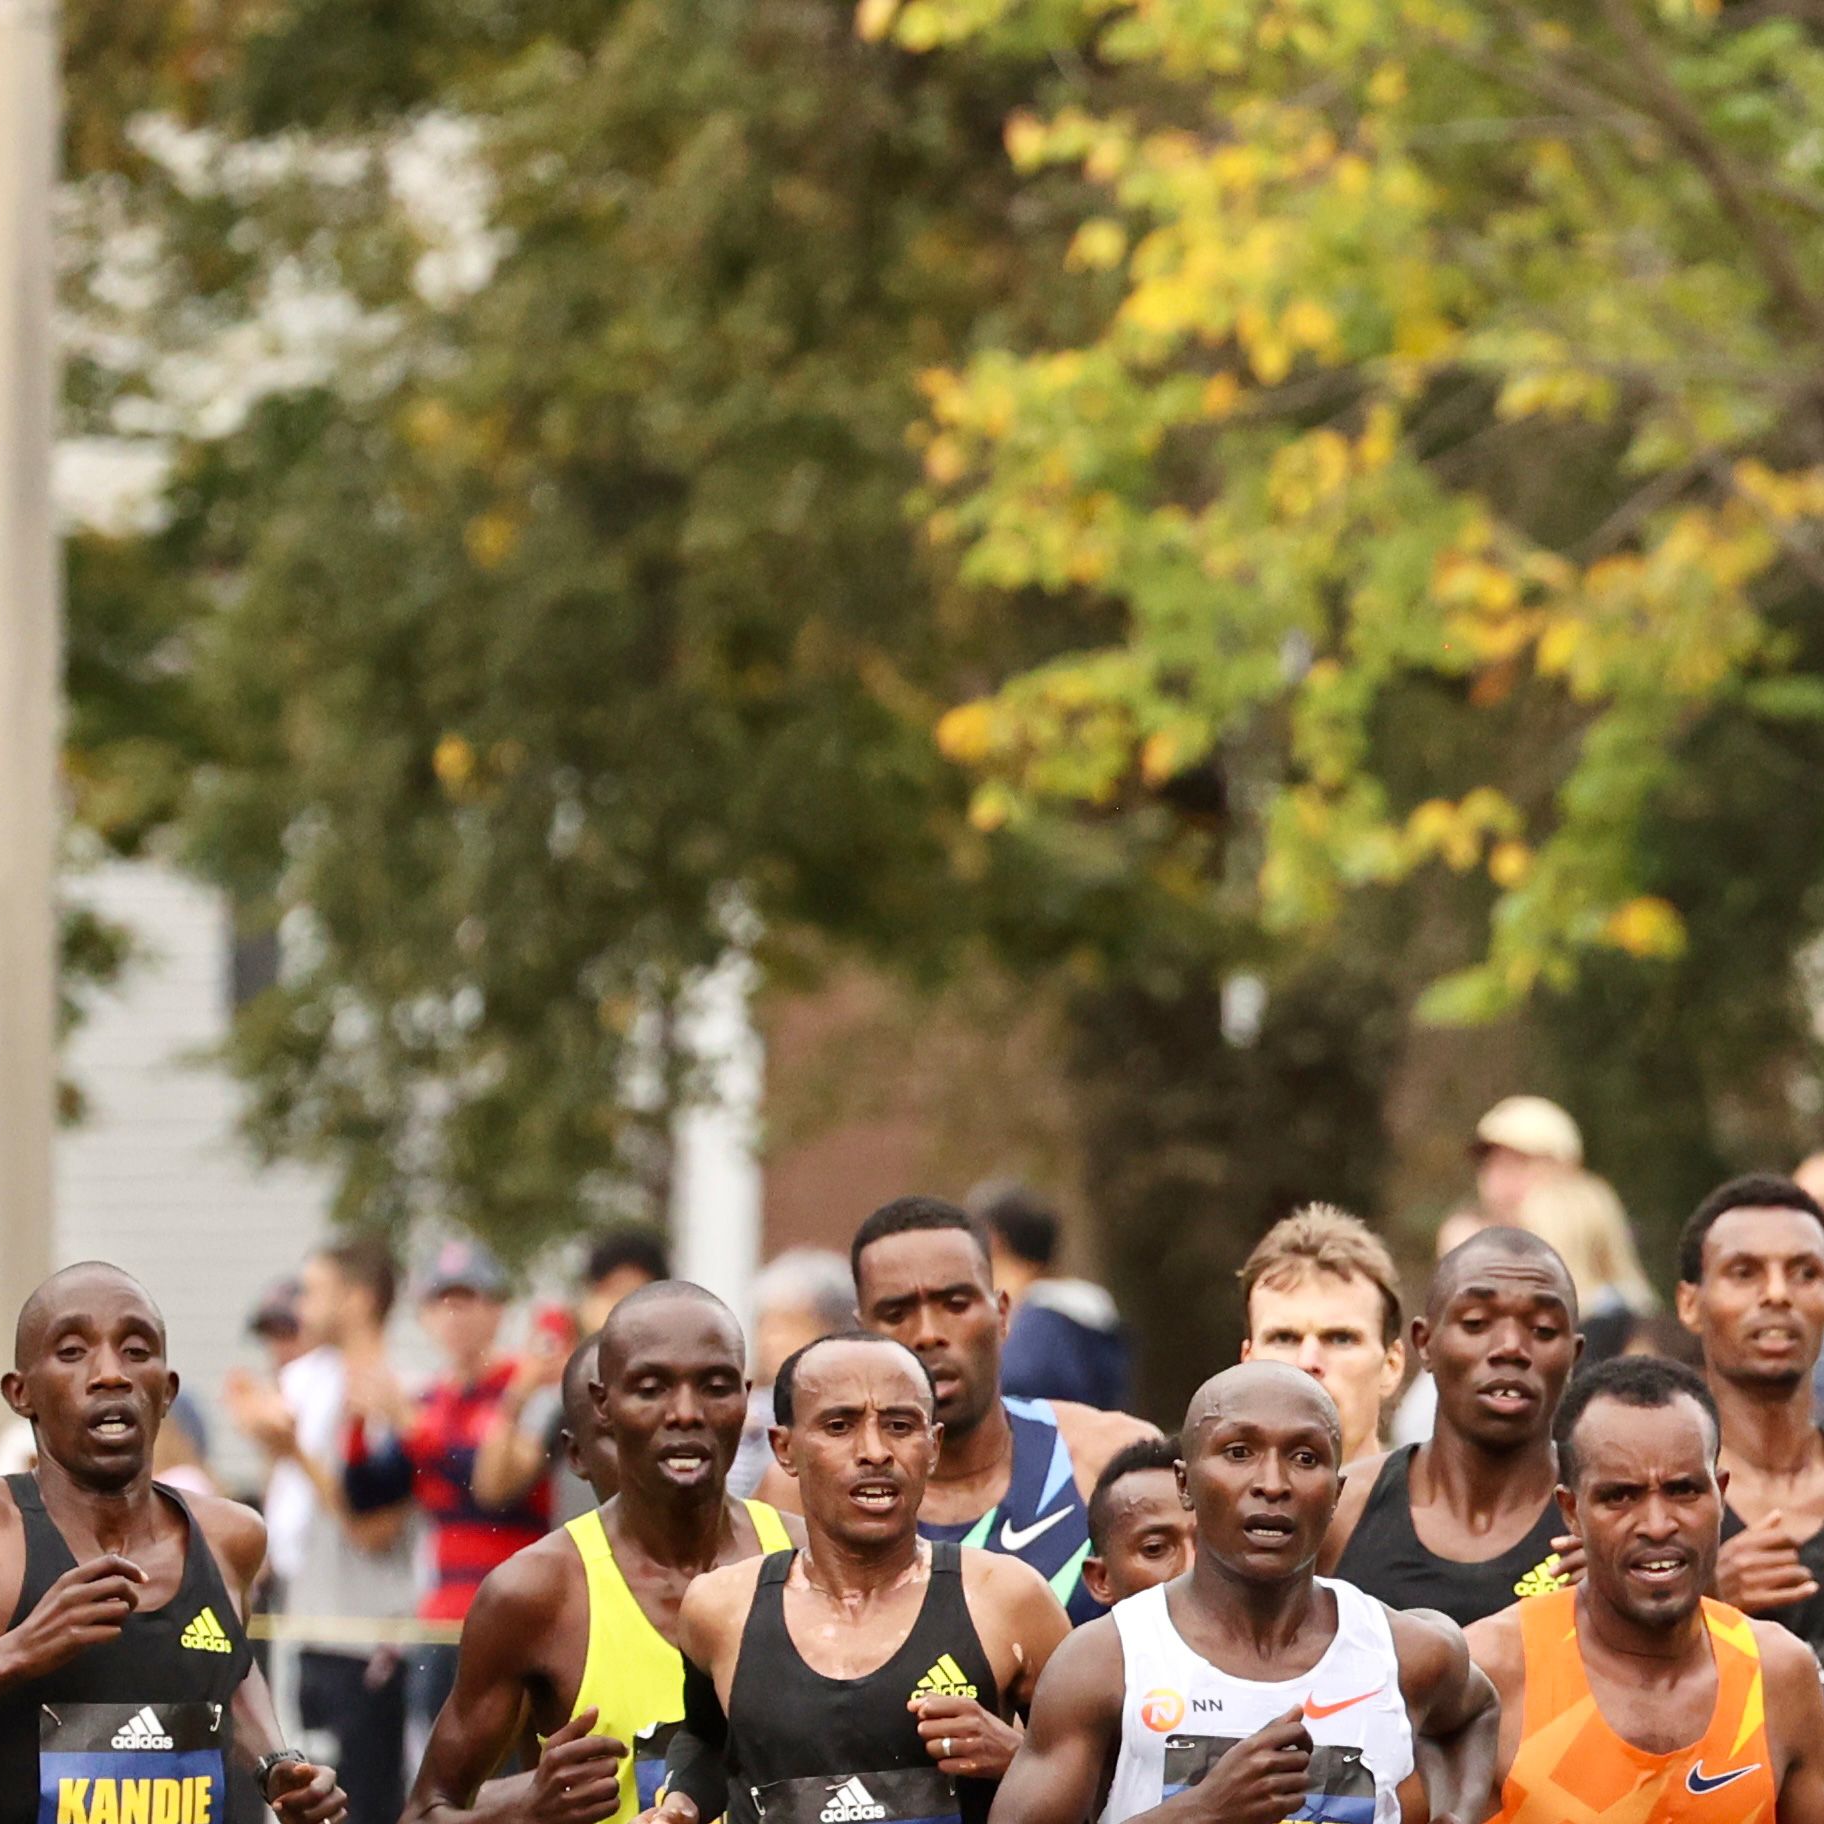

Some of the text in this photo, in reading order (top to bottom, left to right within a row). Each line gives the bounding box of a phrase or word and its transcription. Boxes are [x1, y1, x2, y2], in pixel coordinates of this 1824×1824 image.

[180, 1631, 232, 1655] adidas
[1193, 1699, 1223, 1713] NN
[111, 1734, 174, 1750] adidas
[820, 1803, 886, 1823] adidas
